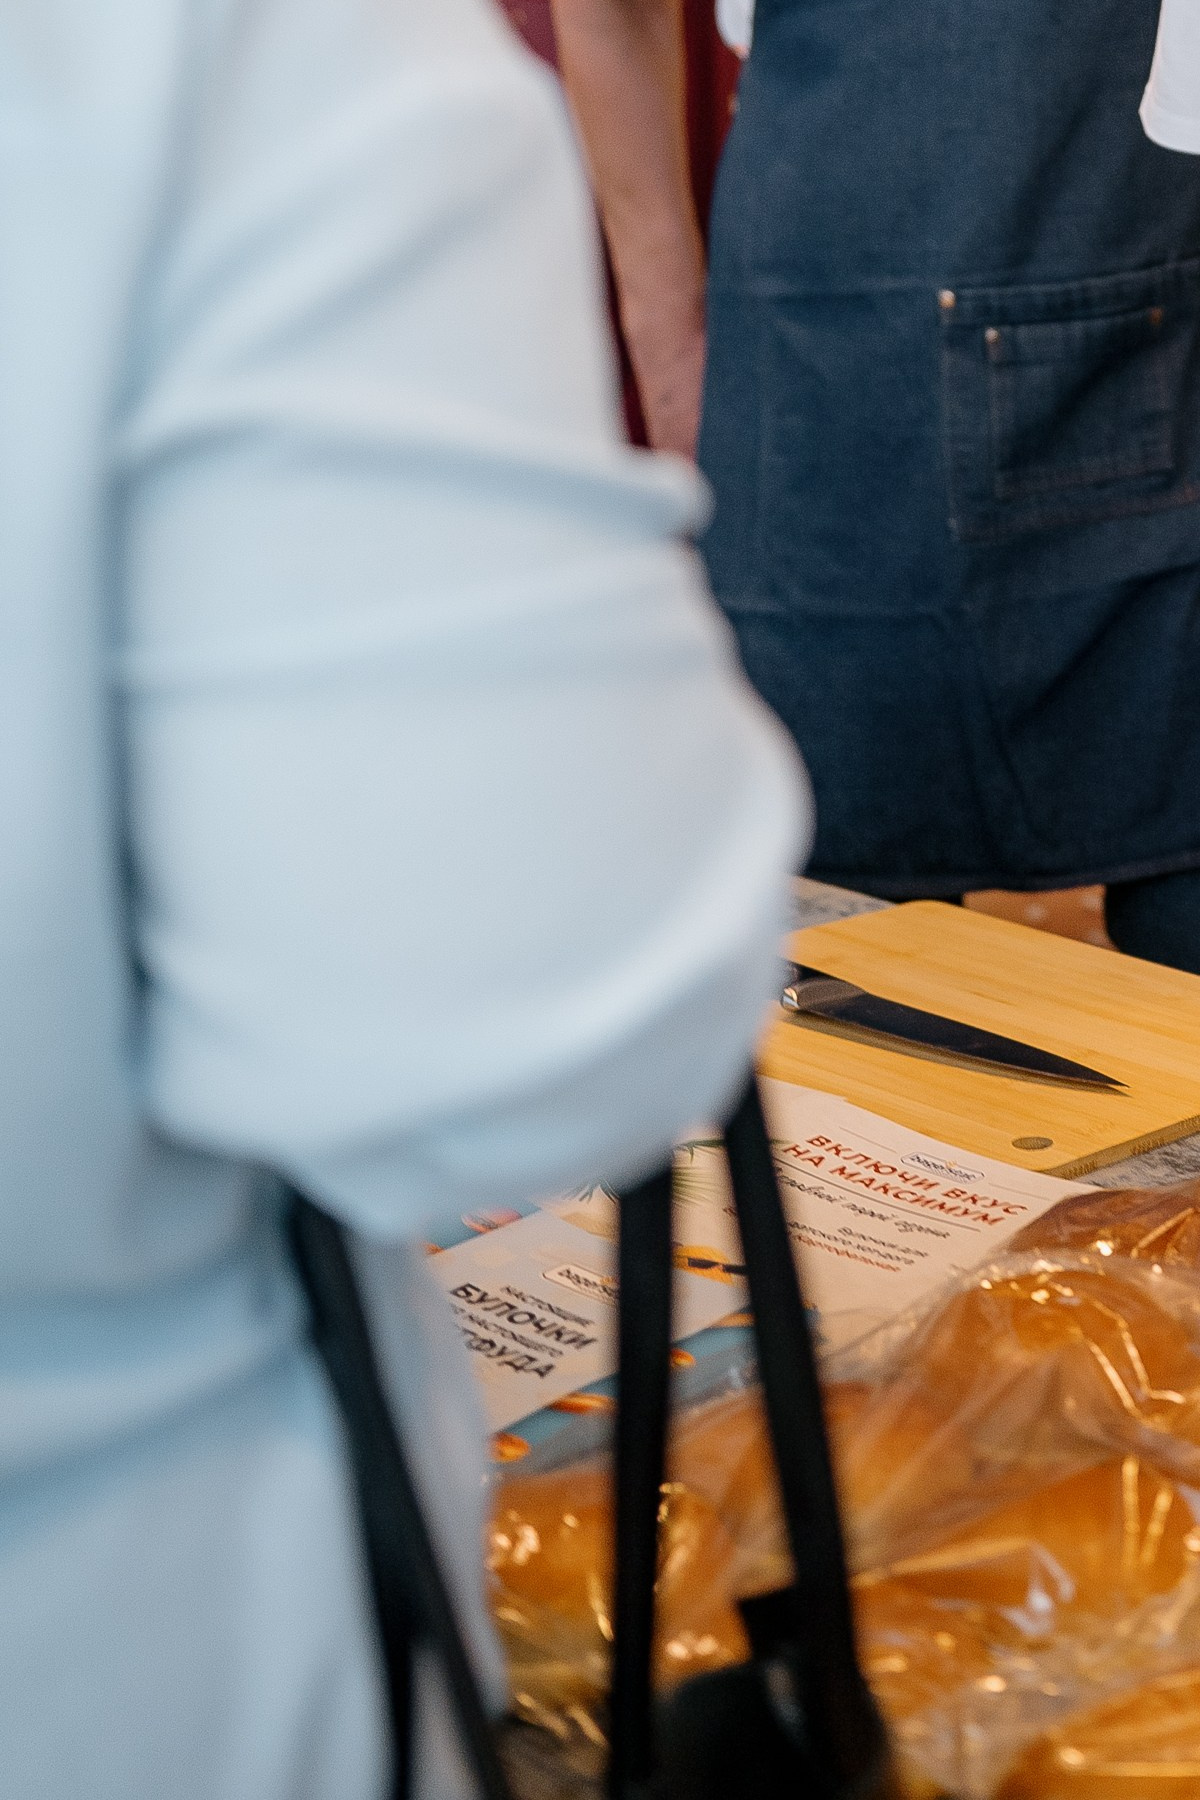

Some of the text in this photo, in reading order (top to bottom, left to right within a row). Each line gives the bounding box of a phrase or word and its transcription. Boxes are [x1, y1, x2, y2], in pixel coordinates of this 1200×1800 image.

[782, 1144, 826, 1168] НА
[828, 1165, 1006, 1226] МАКСИМУМ
[806, 1135, 940, 1191] ВКЛЮЧИ
[941, 1187, 1028, 1216] ВКУС
[450, 1282, 598, 1350] БУЛОЧКИ
